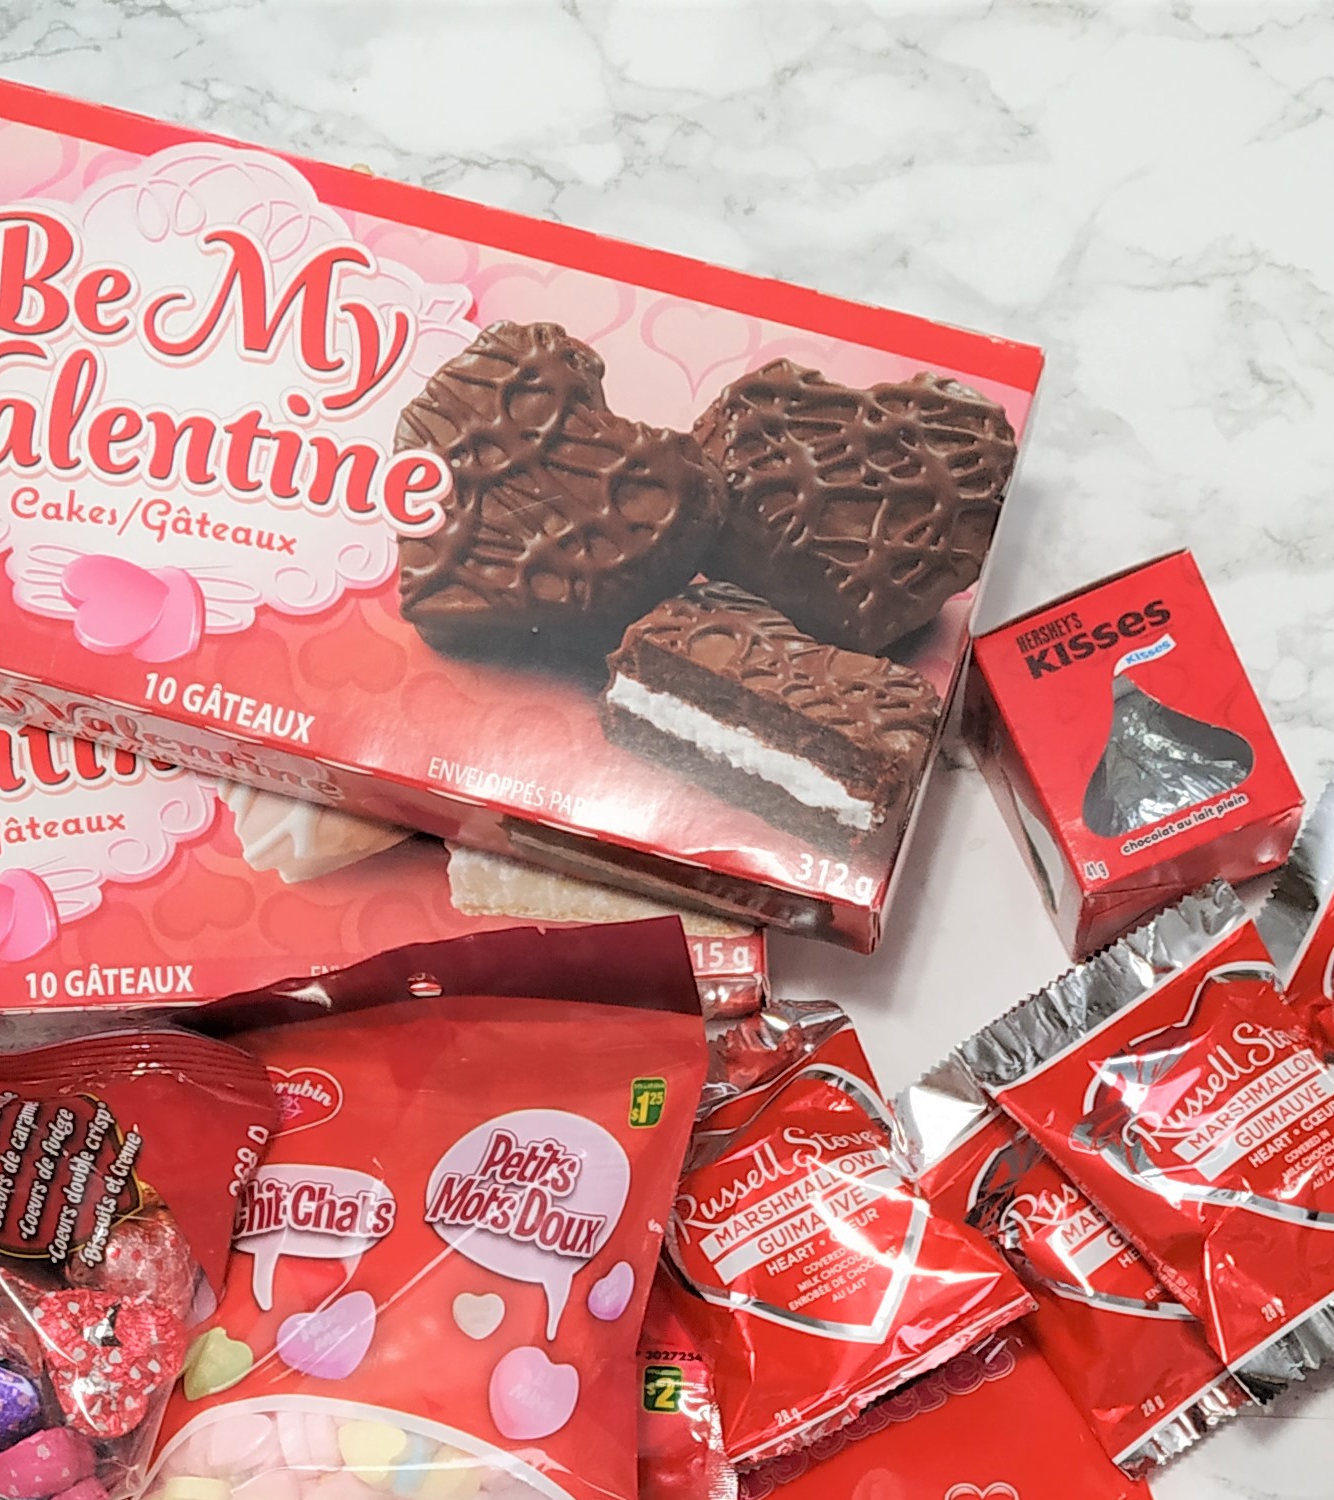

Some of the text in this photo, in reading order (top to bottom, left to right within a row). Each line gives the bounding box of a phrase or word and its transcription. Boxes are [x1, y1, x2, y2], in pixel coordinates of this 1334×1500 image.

[142, 229, 409, 402] My
[9, 487, 297, 556] Cakes/Gâteaux
[1016, 612, 1083, 654] HERSHEY'S
[144, 672, 315, 744] 10 GÂTEAUX
[428, 757, 547, 804] ENVELOPPÉS
[1122, 793, 1247, 853] chocolat au lait plein
[794, 852, 849, 891] 312
[25, 965, 195, 999] 10 GÂTEAUX
[1122, 1044, 1240, 1153] Russell
[1234, 1082, 1327, 1149] GUIMAUVE
[0, 1149, 21, 1174] de
[20, 1107, 74, 1237] Coeurs de fudge
[62, 1150, 95, 1204] double
[479, 1133, 578, 1194] Petits
[1247, 1135, 1294, 1168] HEART
[103, 1174, 126, 1195] et
[675, 1141, 795, 1245] Russell
[48, 1205, 78, 1261] Coeurs
[429, 1176, 603, 1254] Mots Doux
[766, 1240, 816, 1277] HEART
